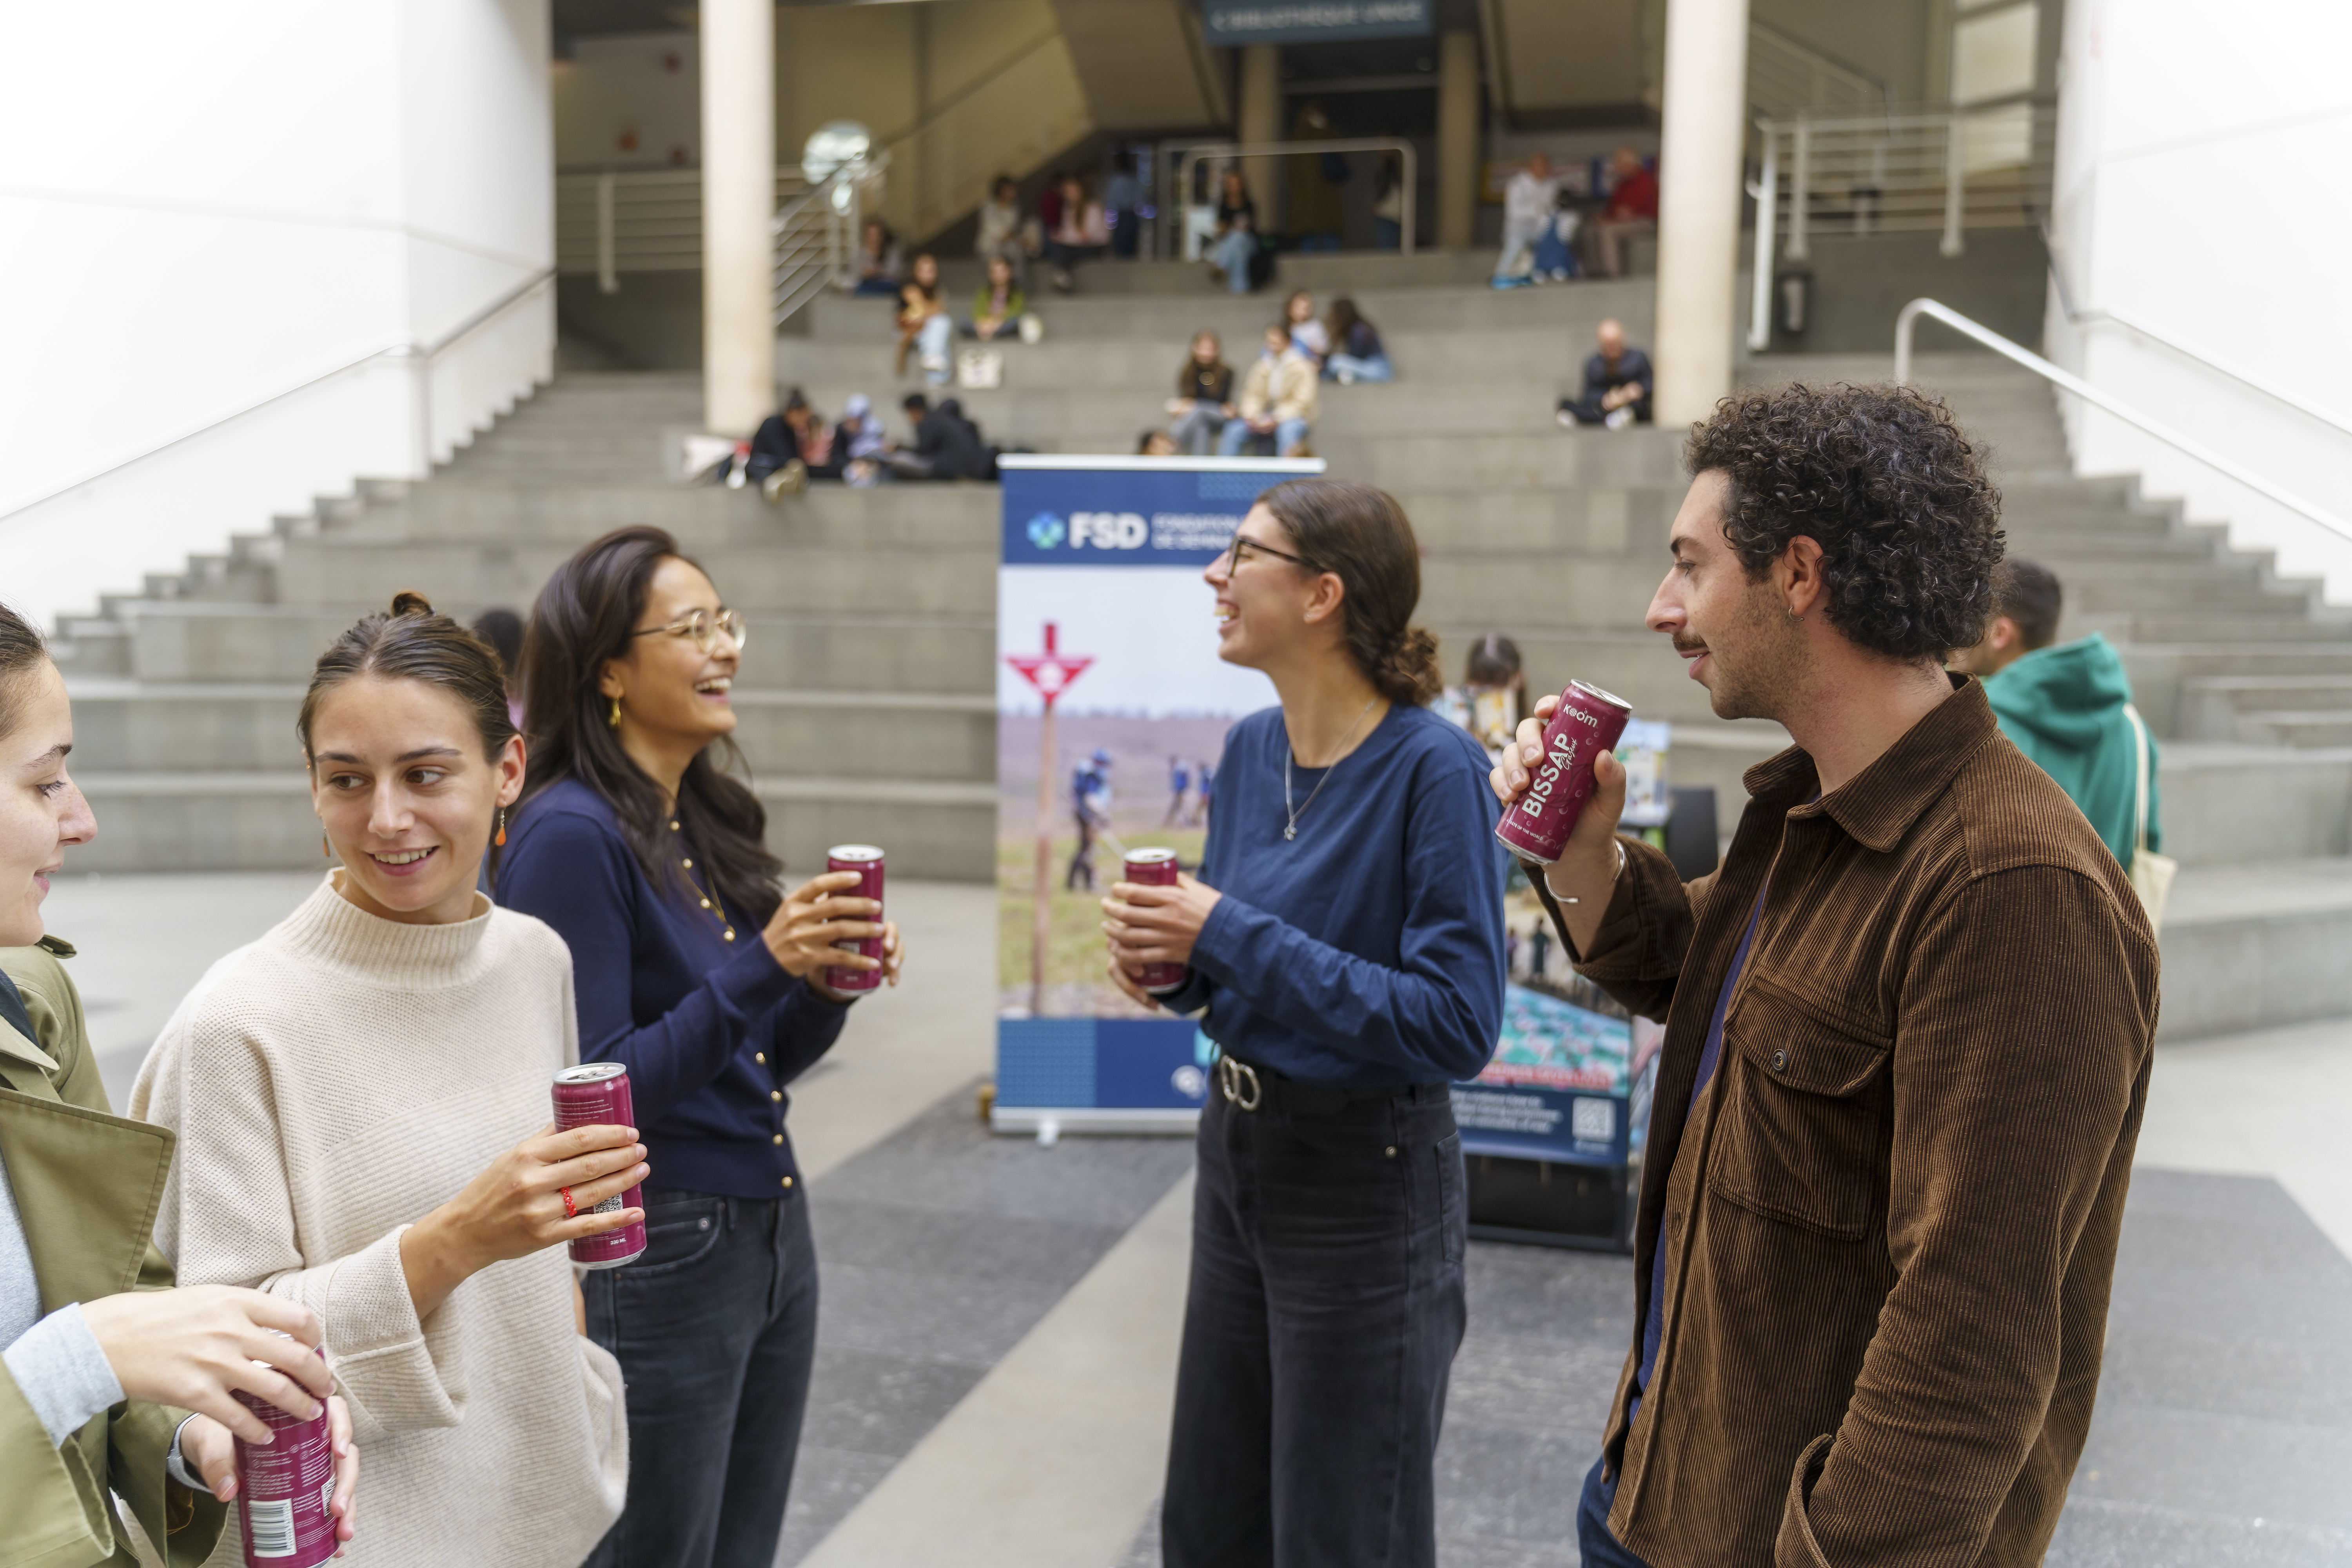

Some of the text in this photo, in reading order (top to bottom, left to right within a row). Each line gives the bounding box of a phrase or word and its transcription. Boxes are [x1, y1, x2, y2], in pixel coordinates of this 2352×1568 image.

[1069, 511, 1149, 550] FSD
[1522, 733, 1570, 818] BISSAP
[1530, 831, 1543, 841] WORLD
